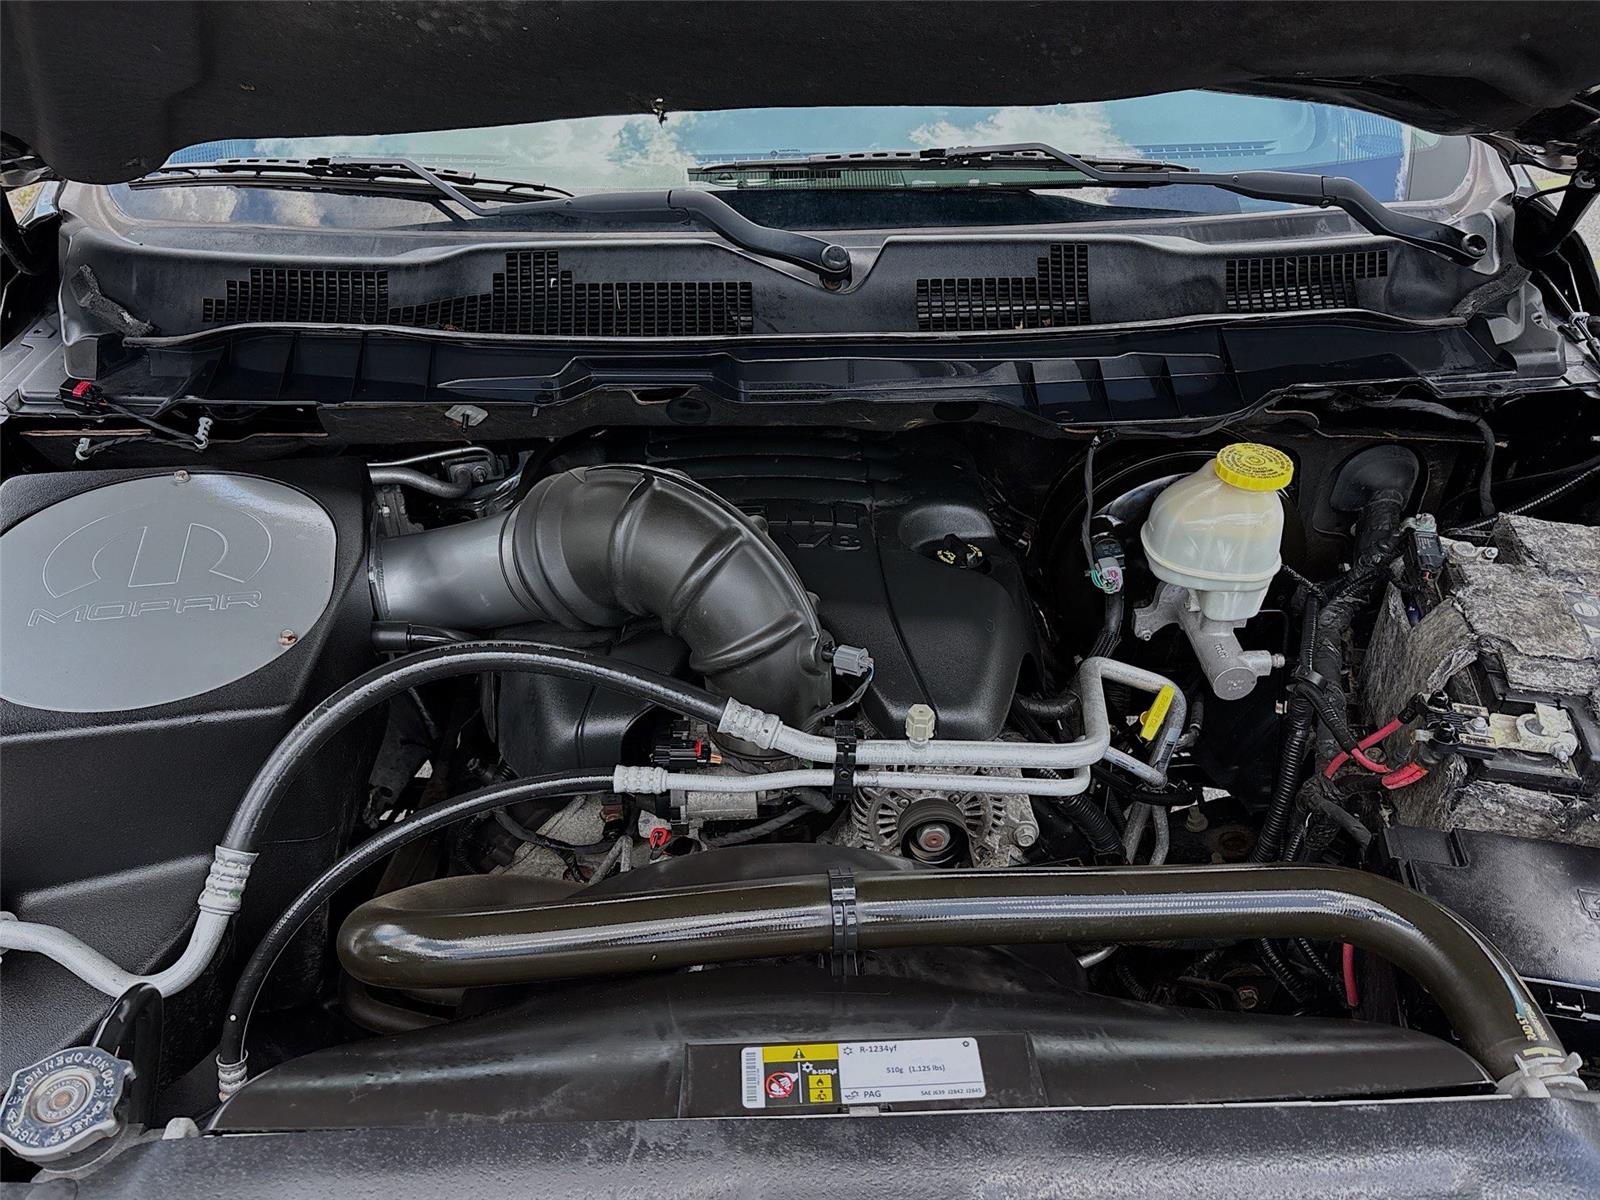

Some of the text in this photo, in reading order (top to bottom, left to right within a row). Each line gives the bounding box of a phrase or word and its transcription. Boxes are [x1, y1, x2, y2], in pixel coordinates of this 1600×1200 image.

[27, 590, 262, 627] MOPAR
[859, 1044, 897, 1054] R-1234yf
[45, 1052, 83, 1071] OPEN
[84, 1053, 109, 1071] NOT
[886, 1066, 904, 1074] 510g
[17, 1067, 43, 1093] HOT
[863, 1090, 881, 1098] PAG
[50, 1114, 94, 1143] KEEP
